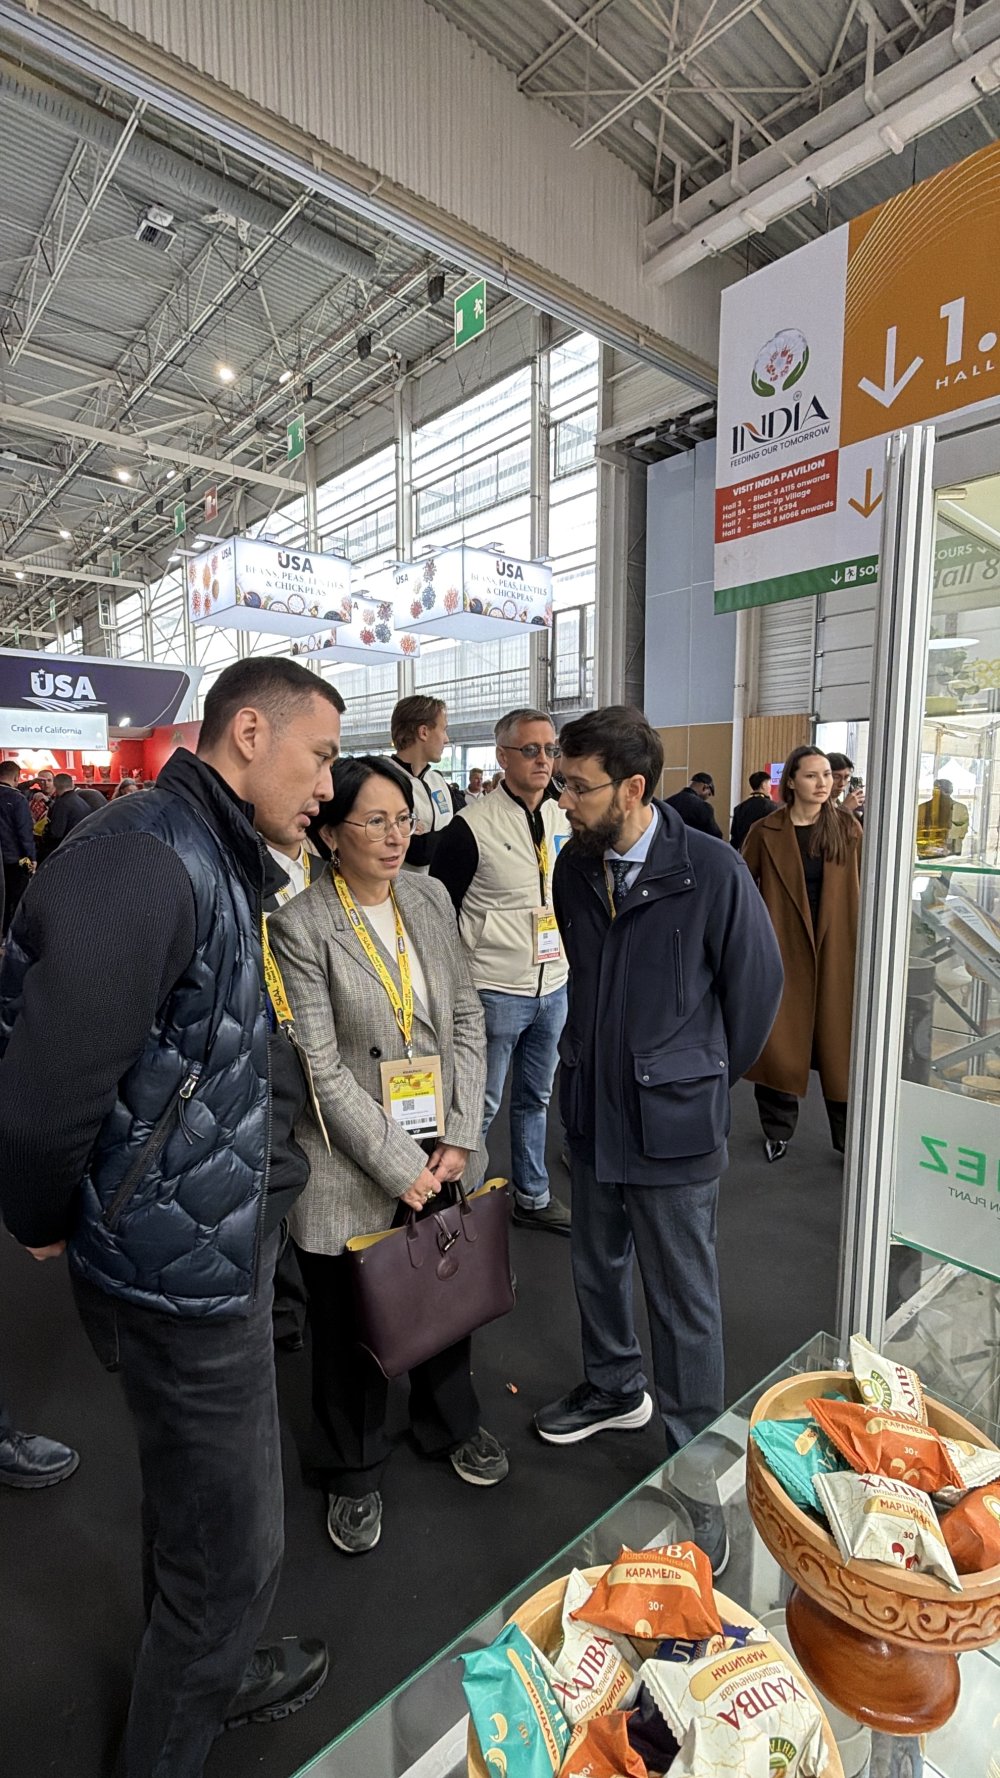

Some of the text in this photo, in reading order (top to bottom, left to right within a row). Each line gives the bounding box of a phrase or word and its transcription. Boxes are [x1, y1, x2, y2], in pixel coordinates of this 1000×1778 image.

[936, 360, 995, 390] HALL
[732, 395, 830, 455] INDIA
[730, 425, 830, 468] FEEDING OUR TOMORROW
[732, 459, 826, 496] VISIT INDIA PAVILION
[722, 502, 736, 511] Hall
[753, 491, 772, 502] Block
[796, 473, 830, 488] onwards
[722, 511, 736, 520] Hall
[752, 497, 784, 511] Start-Up
[785, 488, 811, 501] Village
[722, 520, 736, 529] Hall
[752, 509, 772, 520] Block
[722, 529, 736, 538] Hall
[752, 518, 771, 529] Block
[800, 500, 834, 515] onwards
[221, 547, 232, 560] USA
[277, 551, 314, 574] USA
[395, 573, 409, 585] USA
[495, 558, 524, 581] USA
[275, 580, 327, 597] CHICKPEAS
[493, 587, 534, 603] CHICKPEAS
[519, 583, 548, 596] LENTILS
[30, 670, 97, 700] USA
[34, 725, 43, 733] of
[44, 726, 82, 735] California
[903, 1531, 914, 1540] 30
[625, 1567, 682, 1580] КАРАМЕЛЬ
[648, 1601, 659, 1611] 30
[711, 1649, 768, 1681] МАРЦИПАН
[591, 1670, 628, 1720] АРЦИПАН
[716, 1675, 807, 1730] ХАЛВА
[527, 1681, 558, 1760] МИНДАЛЬ
